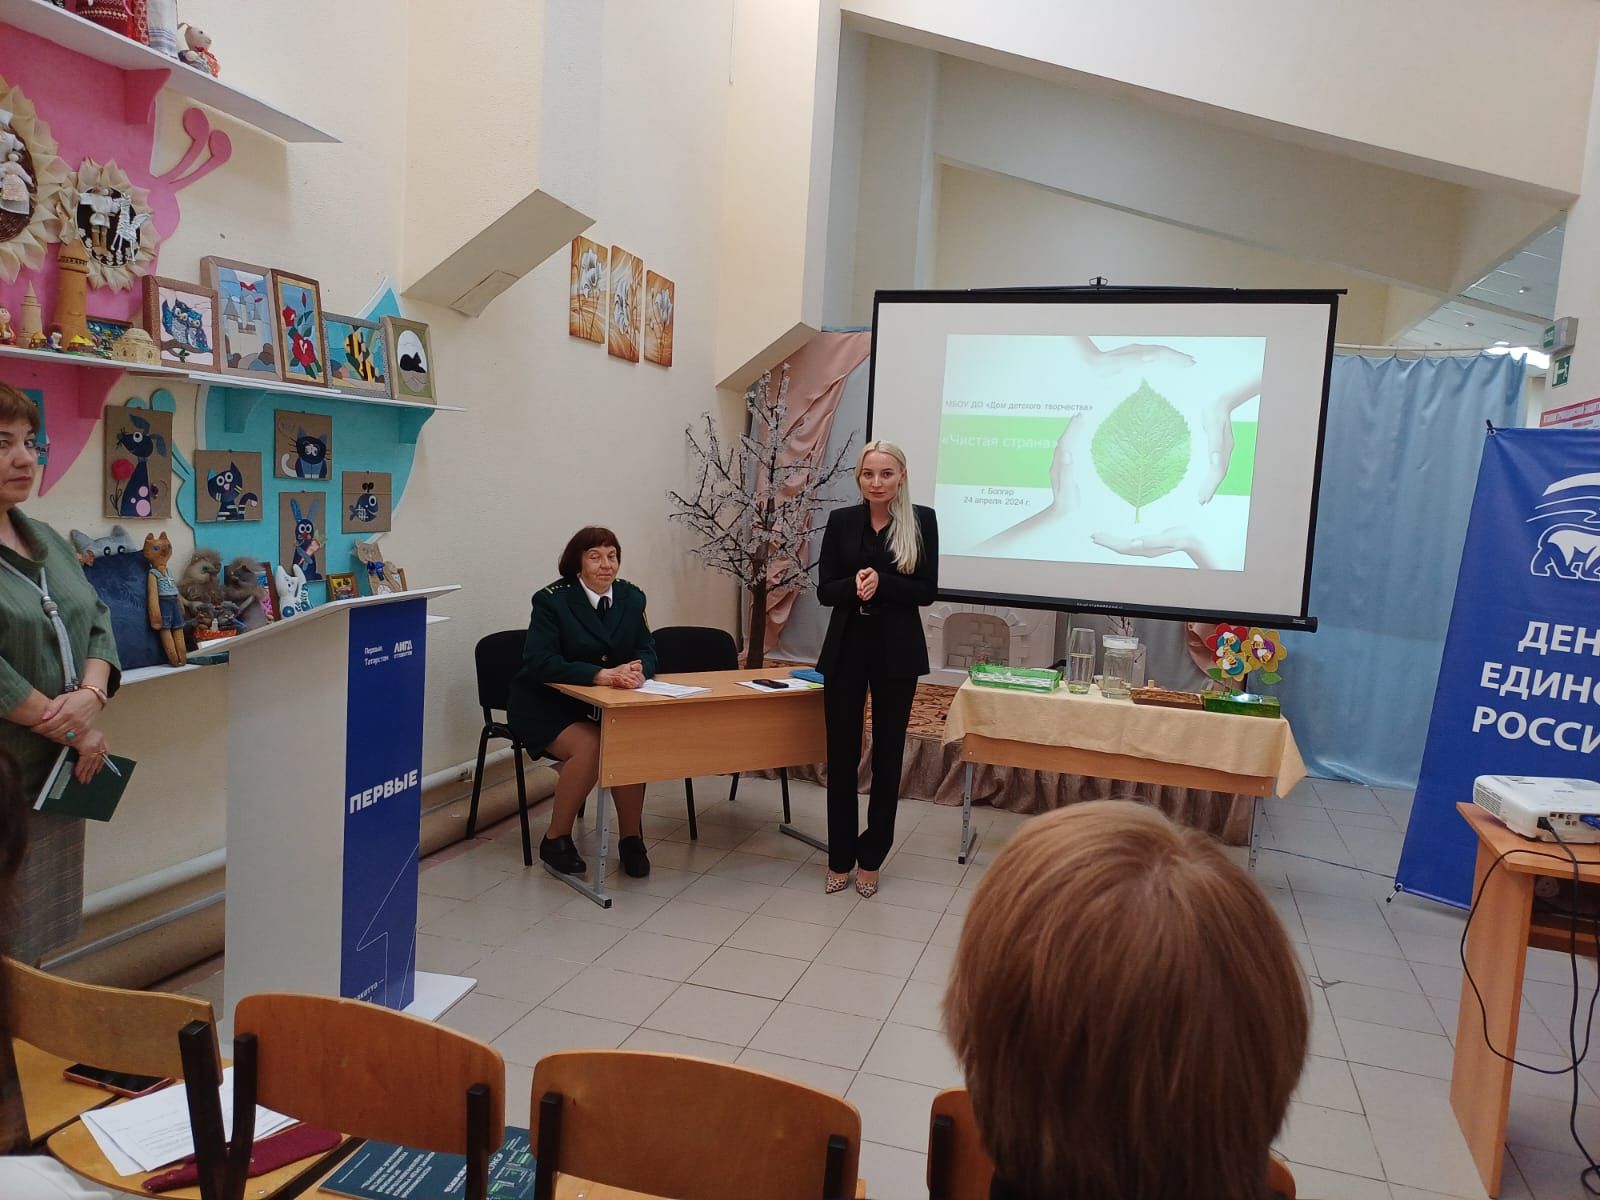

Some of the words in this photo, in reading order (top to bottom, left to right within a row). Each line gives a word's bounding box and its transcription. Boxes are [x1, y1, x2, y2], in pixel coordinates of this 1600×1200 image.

[970, 401, 984, 409] ДО
[986, 401, 1006, 410] «Дом
[1008, 403, 1041, 411] детского
[942, 433, 999, 448] «Чистая
[963, 496, 973, 504] 24
[1005, 497, 1024, 506] 2024
[349, 769, 418, 814] ПЕРВЫЕ
